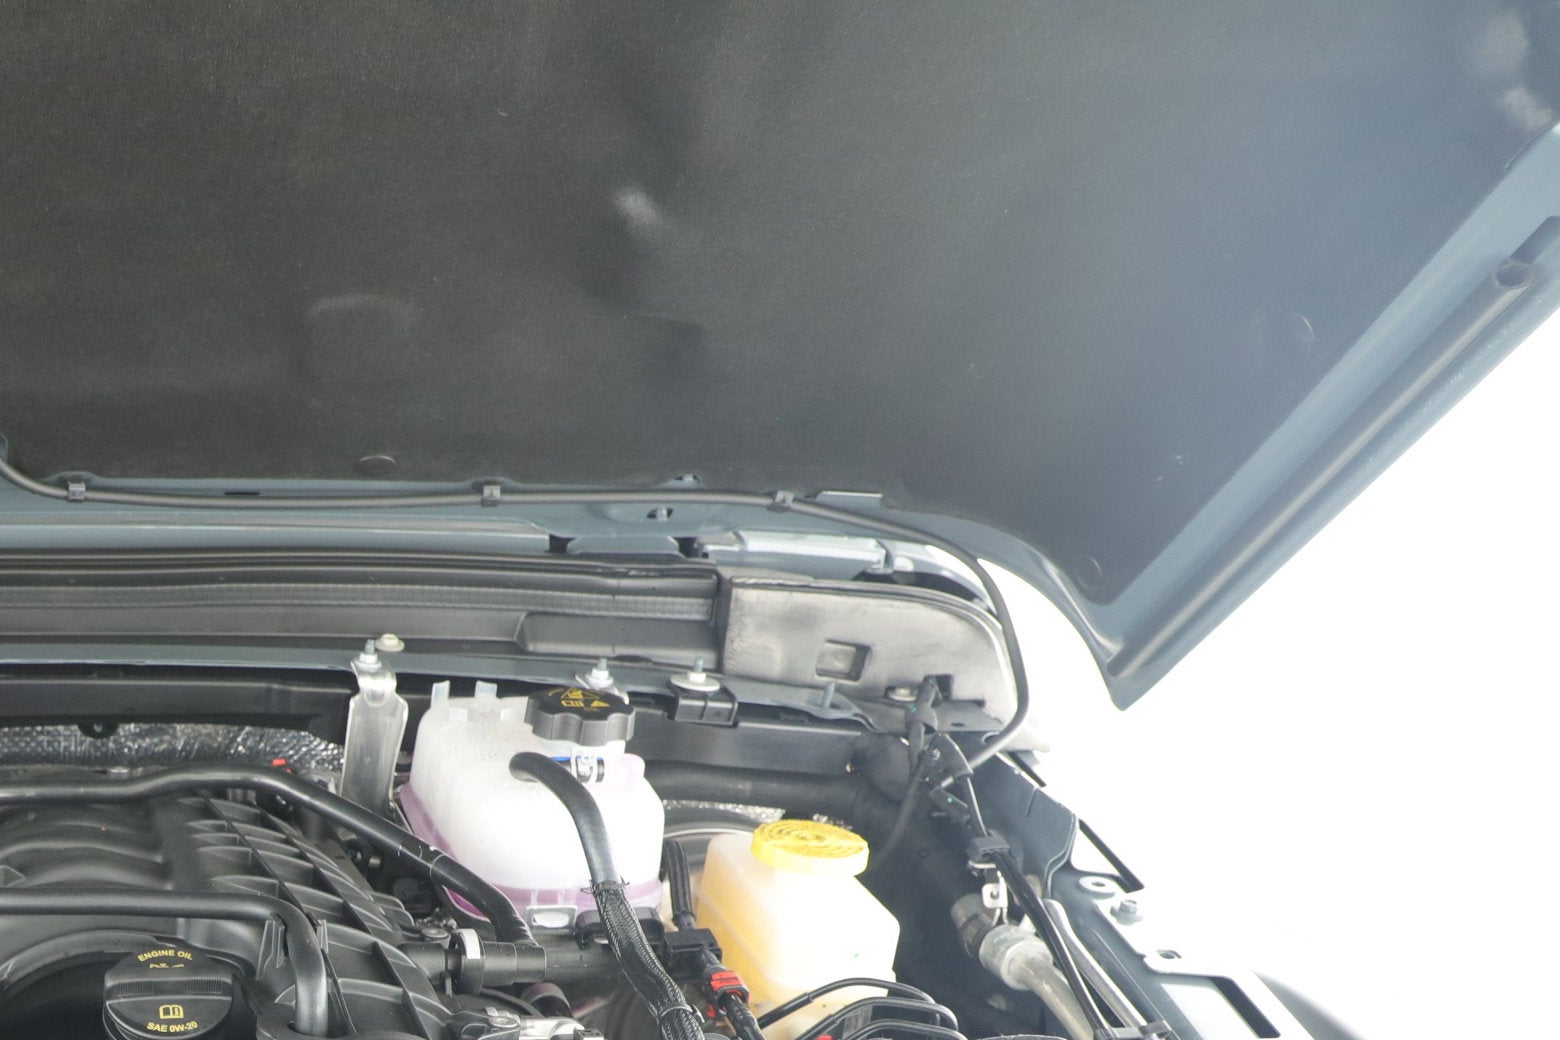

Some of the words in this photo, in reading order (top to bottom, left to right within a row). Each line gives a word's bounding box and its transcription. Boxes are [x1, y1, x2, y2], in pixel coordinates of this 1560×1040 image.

[138, 950, 175, 961] ENGINE
[177, 951, 193, 960] OIL
[147, 1022, 167, 1032] SAE
[170, 1021, 197, 1032] 0W-20
